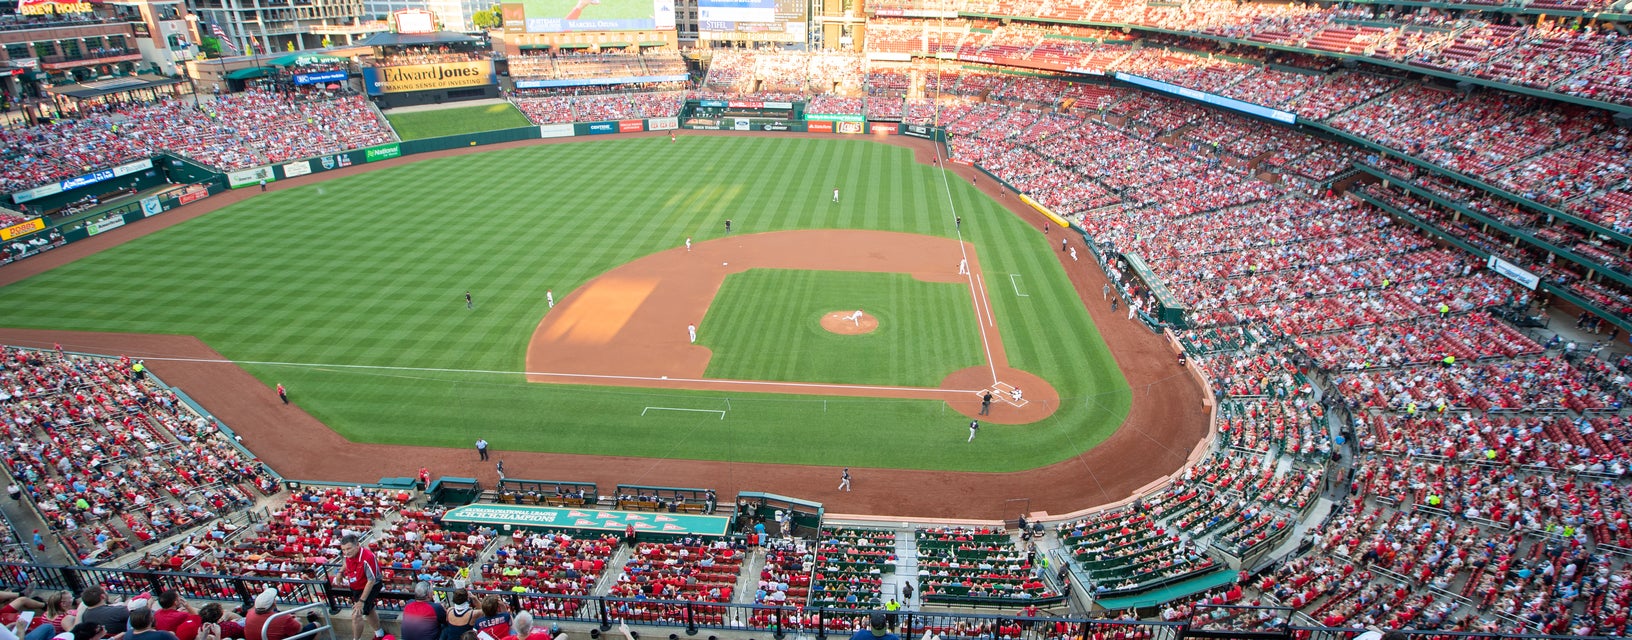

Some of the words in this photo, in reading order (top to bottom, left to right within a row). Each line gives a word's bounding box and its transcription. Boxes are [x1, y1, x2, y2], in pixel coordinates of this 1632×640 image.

[21, 4, 53, 16] BREW
[55, 2, 93, 14] HOUSE
[706, 20, 727, 29] STIFEL
[383, 67, 436, 82] Edward
[439, 65, 479, 80] Jones
[386, 83, 414, 91] MAKING
[840, 121, 861, 134] Lay's
[374, 146, 398, 155] National
[9, 222, 36, 234] DOBBS
